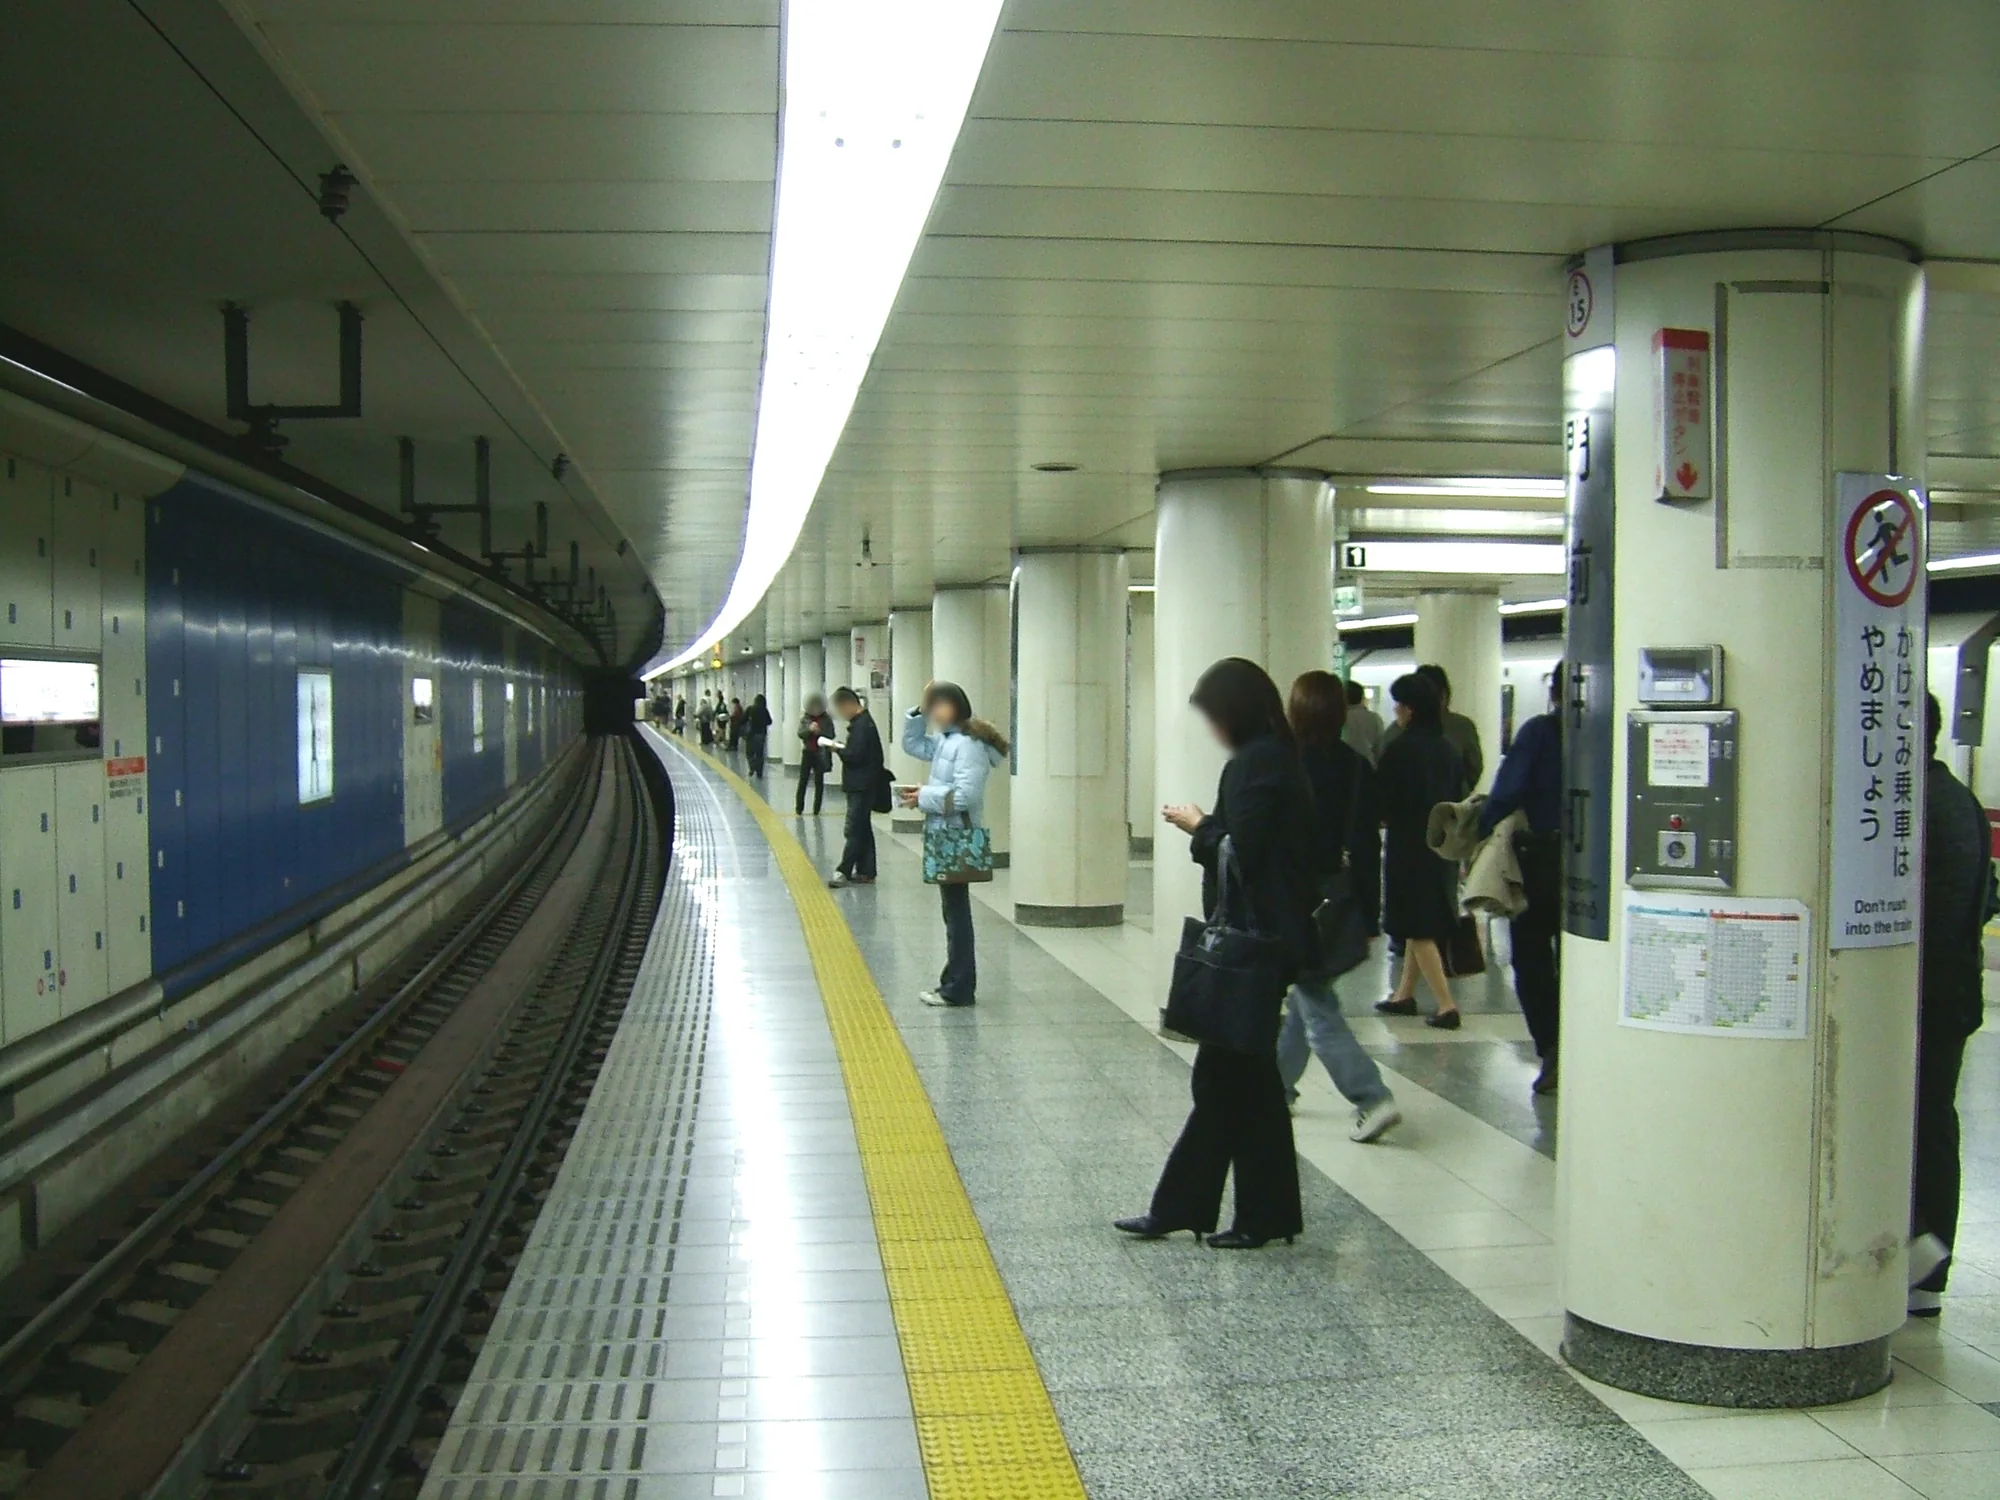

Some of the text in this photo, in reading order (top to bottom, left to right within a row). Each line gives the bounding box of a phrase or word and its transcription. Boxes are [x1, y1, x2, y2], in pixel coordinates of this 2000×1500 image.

[1570, 298, 1585, 324] 15
[1860, 624, 1885, 841] やめましょう
[1893, 625, 1913, 877] かけこみ乗車は
[1854, 899, 1886, 914] Don't
[1845, 921, 1871, 935] into
[1874, 921, 1891, 934] the
